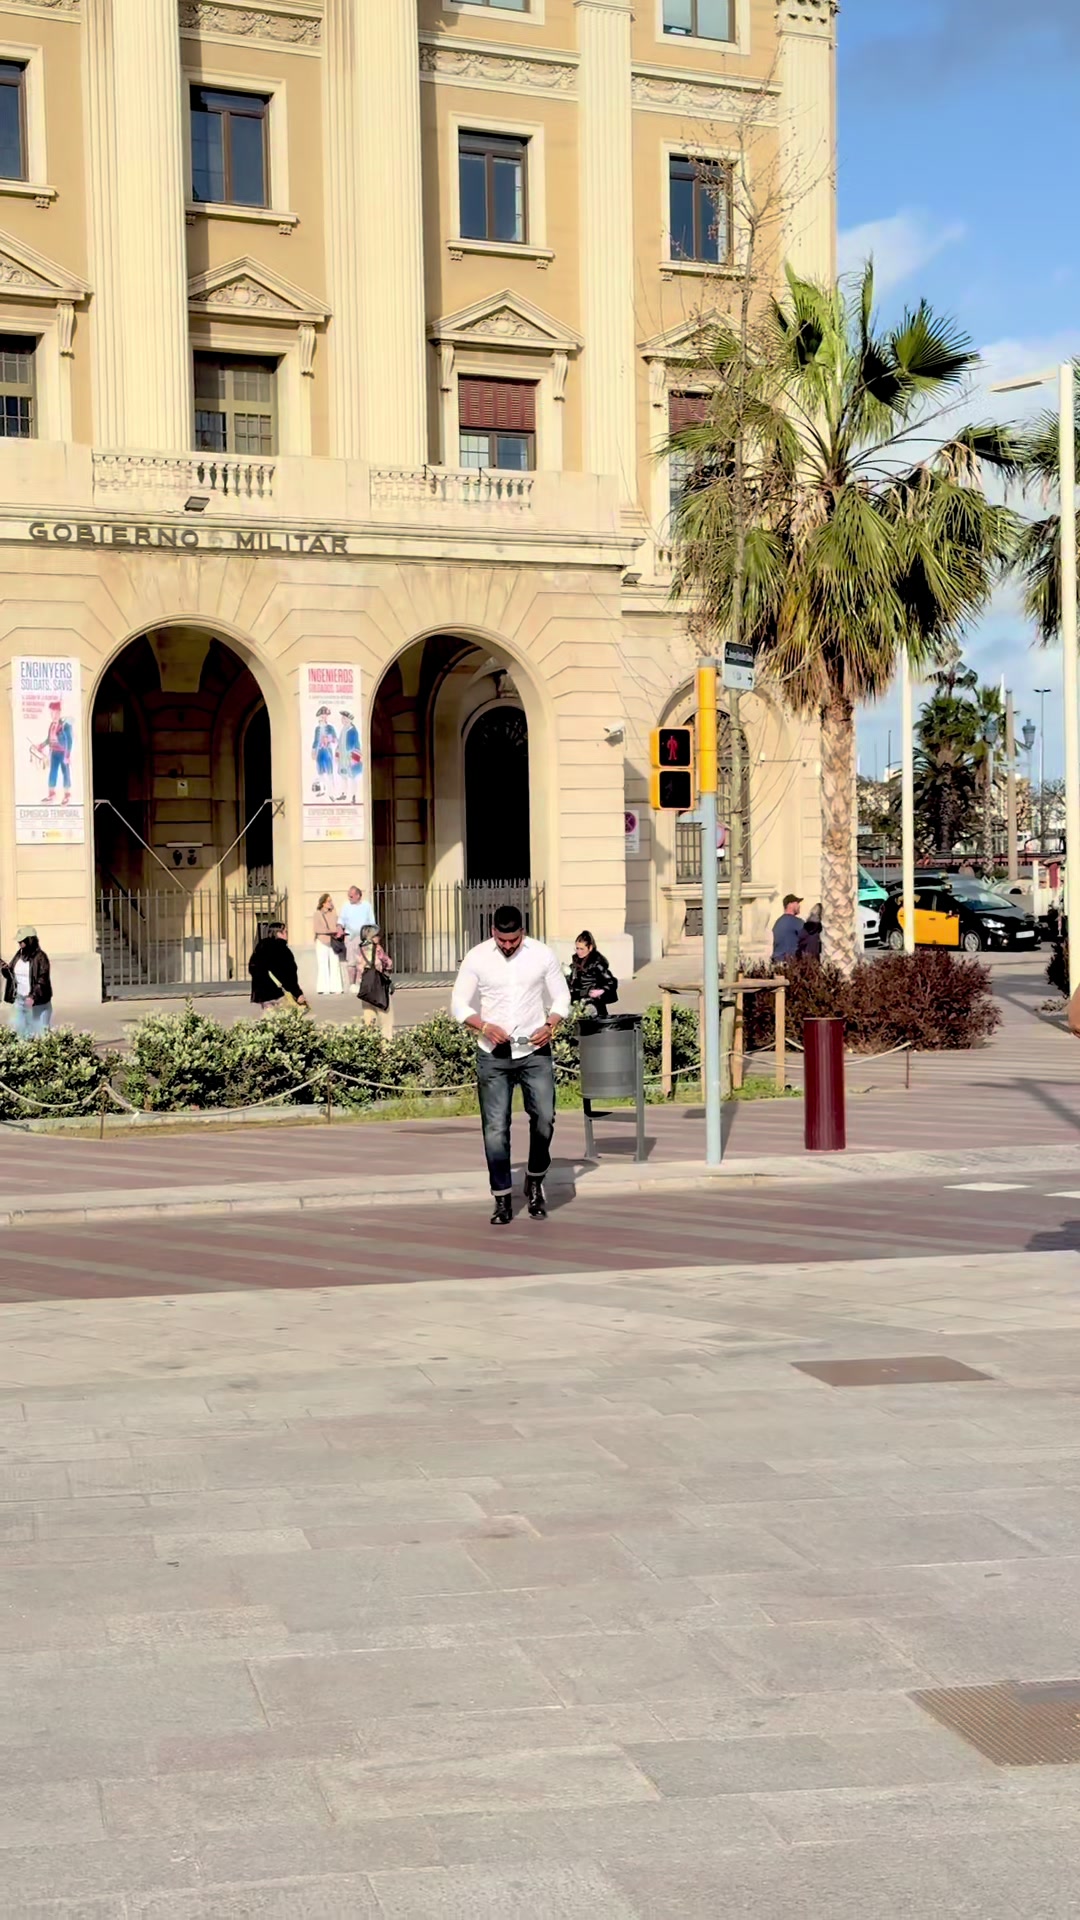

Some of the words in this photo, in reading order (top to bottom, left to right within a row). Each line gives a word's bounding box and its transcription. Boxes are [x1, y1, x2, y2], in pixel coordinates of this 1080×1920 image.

[29, 522, 199, 548] GOBIERNO
[236, 532, 348, 555] MILITAR
[20, 661, 72, 679] ENGINYERS
[308, 668, 354, 683] INGENIEROS
